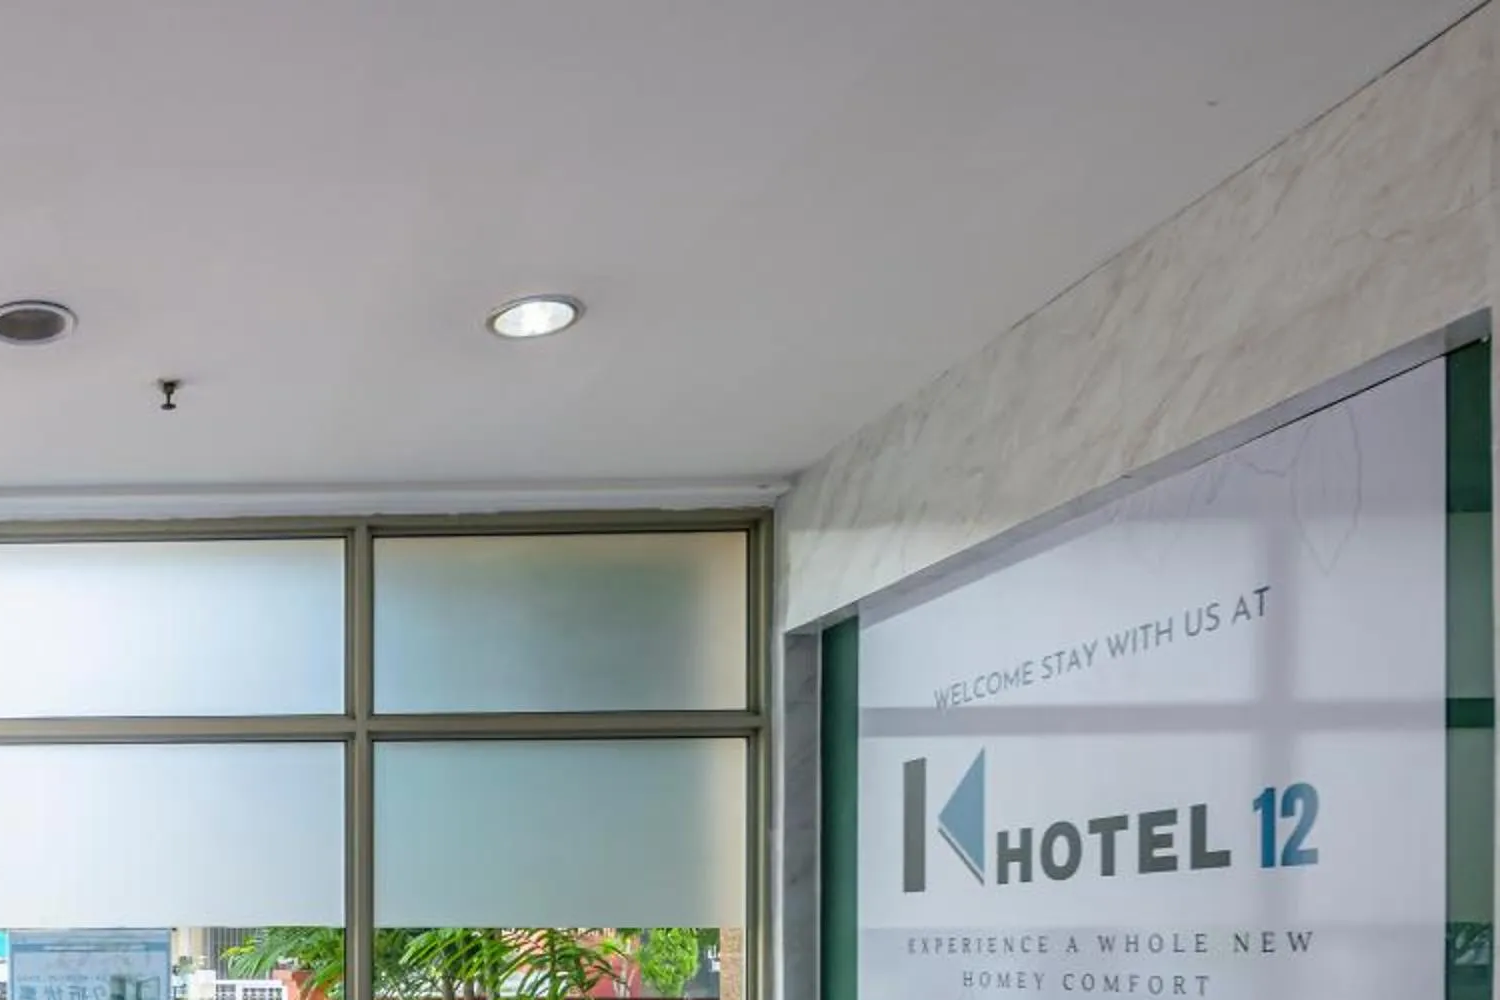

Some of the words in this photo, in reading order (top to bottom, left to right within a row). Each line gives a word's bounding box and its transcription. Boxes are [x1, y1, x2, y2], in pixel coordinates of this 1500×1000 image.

[933, 660, 1034, 713] WELCOME
[1041, 638, 1098, 679] STAY
[1106, 616, 1173, 658] WITH
[1184, 602, 1221, 637] US
[1231, 585, 1271, 626] AT
[1252, 782, 1320, 868] 12
[907, 935, 1049, 955] EXPERIENCE
[1064, 935, 1080, 953] A
[1097, 932, 1209, 954] WHOLE
[1233, 930, 1314, 954] NEW
[963, 970, 1046, 991] HOMEY
[1061, 973, 1210, 997] COMFORT
